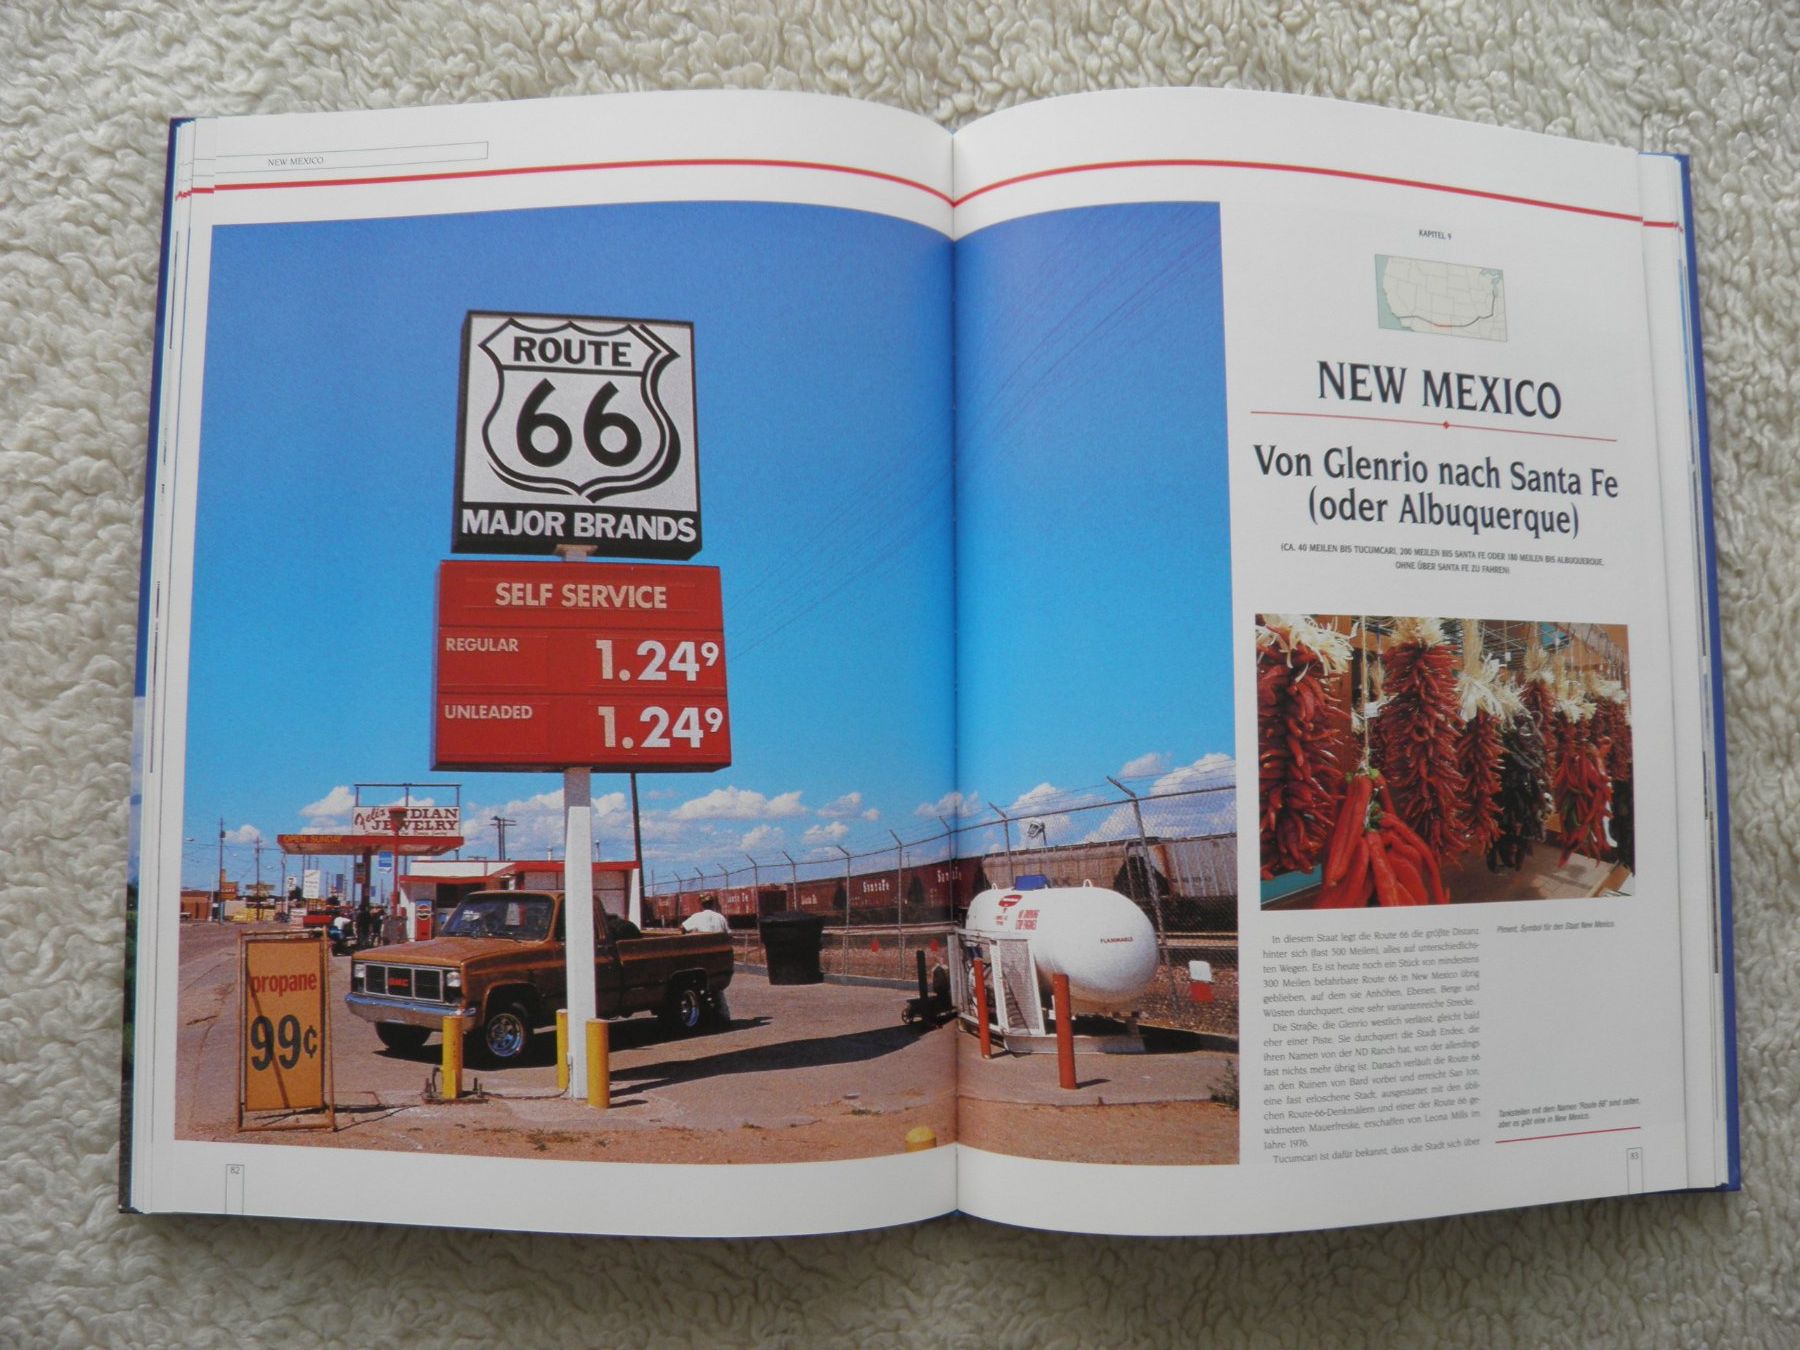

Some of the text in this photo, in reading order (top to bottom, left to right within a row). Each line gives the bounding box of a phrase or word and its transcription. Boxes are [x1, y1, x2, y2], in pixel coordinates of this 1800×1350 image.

[267, 155, 324, 166] NEW MEXICO
[1418, 228, 1446, 240] KAPITEL
[512, 335, 633, 368] ROUTE
[1317, 359, 1562, 420] NEW MEXICO
[515, 377, 643, 468] 66
[1253, 444, 1620, 498] Von Glenrio nach Santa Fe
[1308, 484, 1580, 540] (oder Albuquerque)
[461, 508, 698, 543] MAJOR BRANDS
[1298, 544, 1307, 552] 40
[1309, 544, 1337, 553] MEILEN
[1340, 545, 1352, 553] BIS
[1414, 548, 1440, 557] MEILEN
[1442, 549, 1453, 558] BIS
[1454, 550, 1476, 559] SANTA
[1478, 551, 1486, 560] FE
[1487, 552, 1506, 561] ODER
[1519, 553, 1543, 563] MEILEN
[1545, 555, 1556, 563] BIS
[1395, 560, 1416, 570] OHNE
[1417, 560, 1436, 571] ÜBER
[1437, 562, 1460, 571] SANTA
[1461, 563, 1469, 572] FE
[1471, 564, 1481, 572] ZU
[495, 582, 668, 609] SELF SERVICE
[446, 637, 519, 652] REGULAR
[444, 704, 533, 720] UNLEADED
[1272, 935, 1280, 944] In
[1284, 933, 1314, 943] diesem
[1317, 932, 1338, 941] Staat
[1374, 930, 1396, 939] Route
[1399, 929, 1408, 938] 66
[1263, 949, 1287, 958] hinter
[1291, 949, 1308, 957] sich
[1263, 965, 1277, 974] ten
[1312, 963, 1323, 971] Es
[1337, 961, 1360, 970] heute
[252, 973, 317, 997] propane
[1263, 979, 1279, 988] 300
[1361, 974, 1385, 984] Route
[1388, 974, 1398, 982] 66
[1411, 972, 1427, 981] New
[1328, 991, 1346, 1000] dem
[1347, 1004, 1365, 1013] eine
[1273, 1023, 1287, 1032] Die
[1323, 1020, 1336, 1029] die
[1338, 1018, 1368, 1028] Glenrio
[1263, 1038, 1282, 1046] eher
[1287, 1036, 1308, 1045] einer
[1338, 1034, 1351, 1043] Sie
[1416, 1028, 1437, 1038] Stadt
[1263, 1052, 1285, 1061] ihren
[1288, 1050, 1318, 1060] Namen
[1339, 1049, 1352, 1058] der
[1354, 1048, 1368, 1057] ND
[1371, 1046, 1395, 1056] Ranch
[1263, 1067, 1279, 1076] fast
[1282, 1066, 1307, 1075] nichts
[1310, 1064, 1331, 1074] mehr
[1371, 1059, 1401, 1070] Danach
[1447, 1053, 1469, 1064] Route
[1278, 1081, 1295, 1090] den
[1298, 1079, 1328, 1089] Ruinen
[1349, 1077, 1368, 1086] Bard
[1399, 1073, 1415, 1082] und
[1263, 1096, 1282, 1106] eine
[1286, 1095, 1302, 1104] fast
[1305, 1092, 1351, 1103] erloschene
[1263, 1111, 1285, 1120] chen
[1377, 1103, 1393, 1113] und
[1433, 1097, 1456, 1107] Route
[1263, 1124, 1305, 1134] widmeten
[1407, 1117, 1422, 1125] von
[1272, 1153, 1317, 1163] Tucumcari
[1319, 1152, 1329, 1161] ist
[1332, 1150, 1352, 1160] dafür
[1424, 1141, 1445, 1151] Stadt
[230, 1166, 240, 1175] 82
